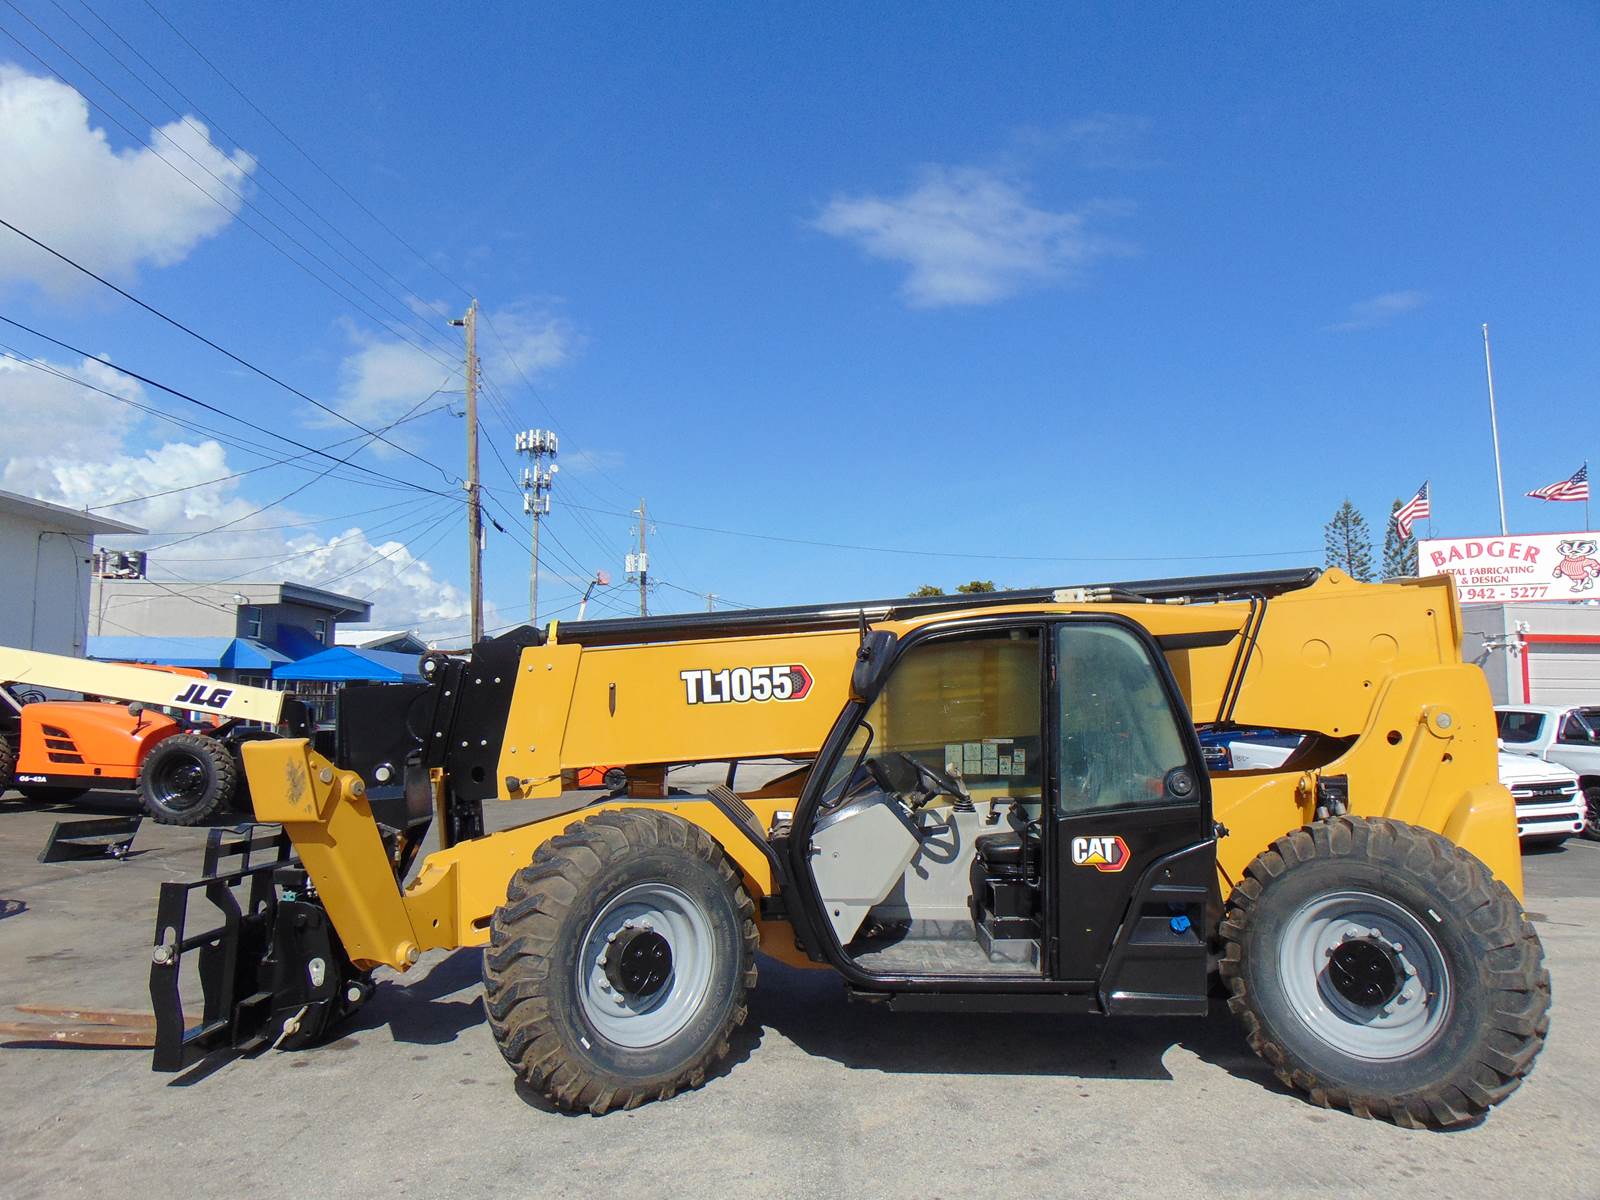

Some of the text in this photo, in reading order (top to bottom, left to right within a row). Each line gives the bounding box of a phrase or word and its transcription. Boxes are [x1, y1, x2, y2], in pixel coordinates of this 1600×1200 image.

[1430, 541, 1541, 567] BADGER
[1461, 575, 1509, 585] & DESIGN
[1470, 565, 1535, 576] FABRICATING
[1467, 588, 1496, 599] 942
[1510, 586, 1548, 599] 5277
[174, 683, 234, 709] JLG
[680, 666, 793, 704] TL1055
[1073, 838, 1115, 864] CAT
